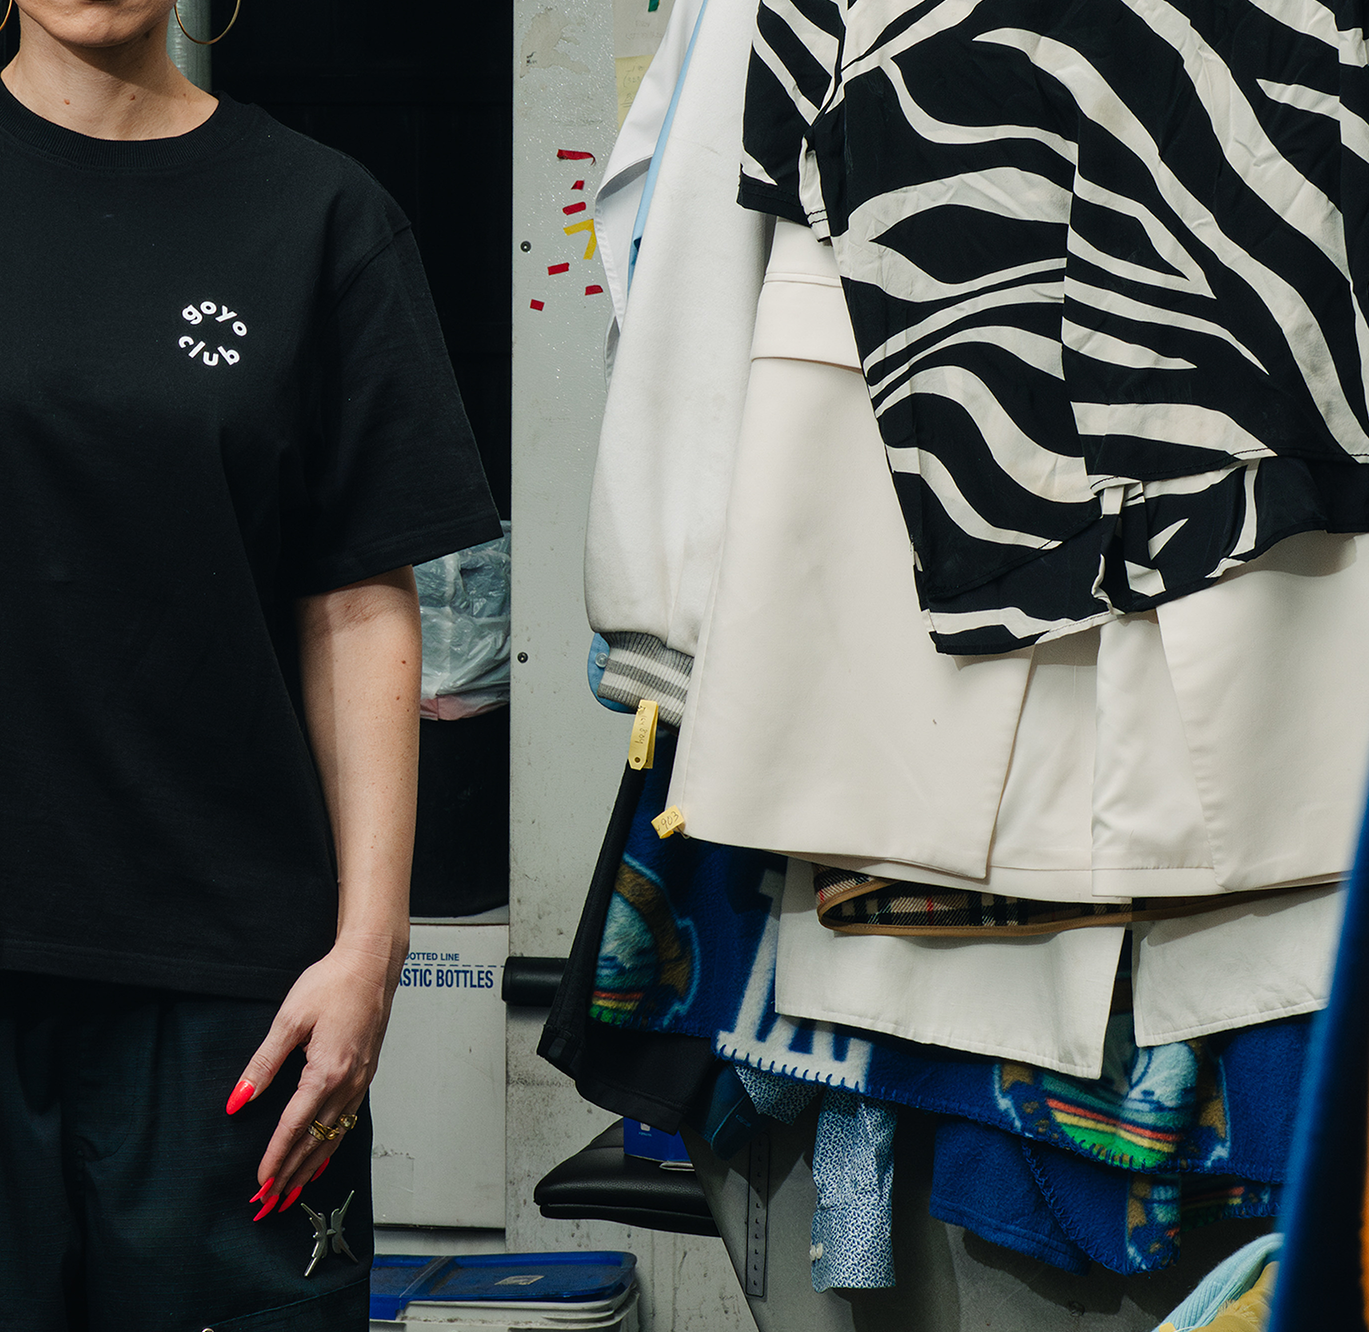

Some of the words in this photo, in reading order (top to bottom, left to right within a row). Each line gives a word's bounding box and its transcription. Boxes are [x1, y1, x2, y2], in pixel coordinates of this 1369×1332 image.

[182, 300, 248, 337] goyo
[178, 336, 240, 367] club
[440, 953, 460, 961] LINE
[436, 969, 494, 989] BOTTLES
